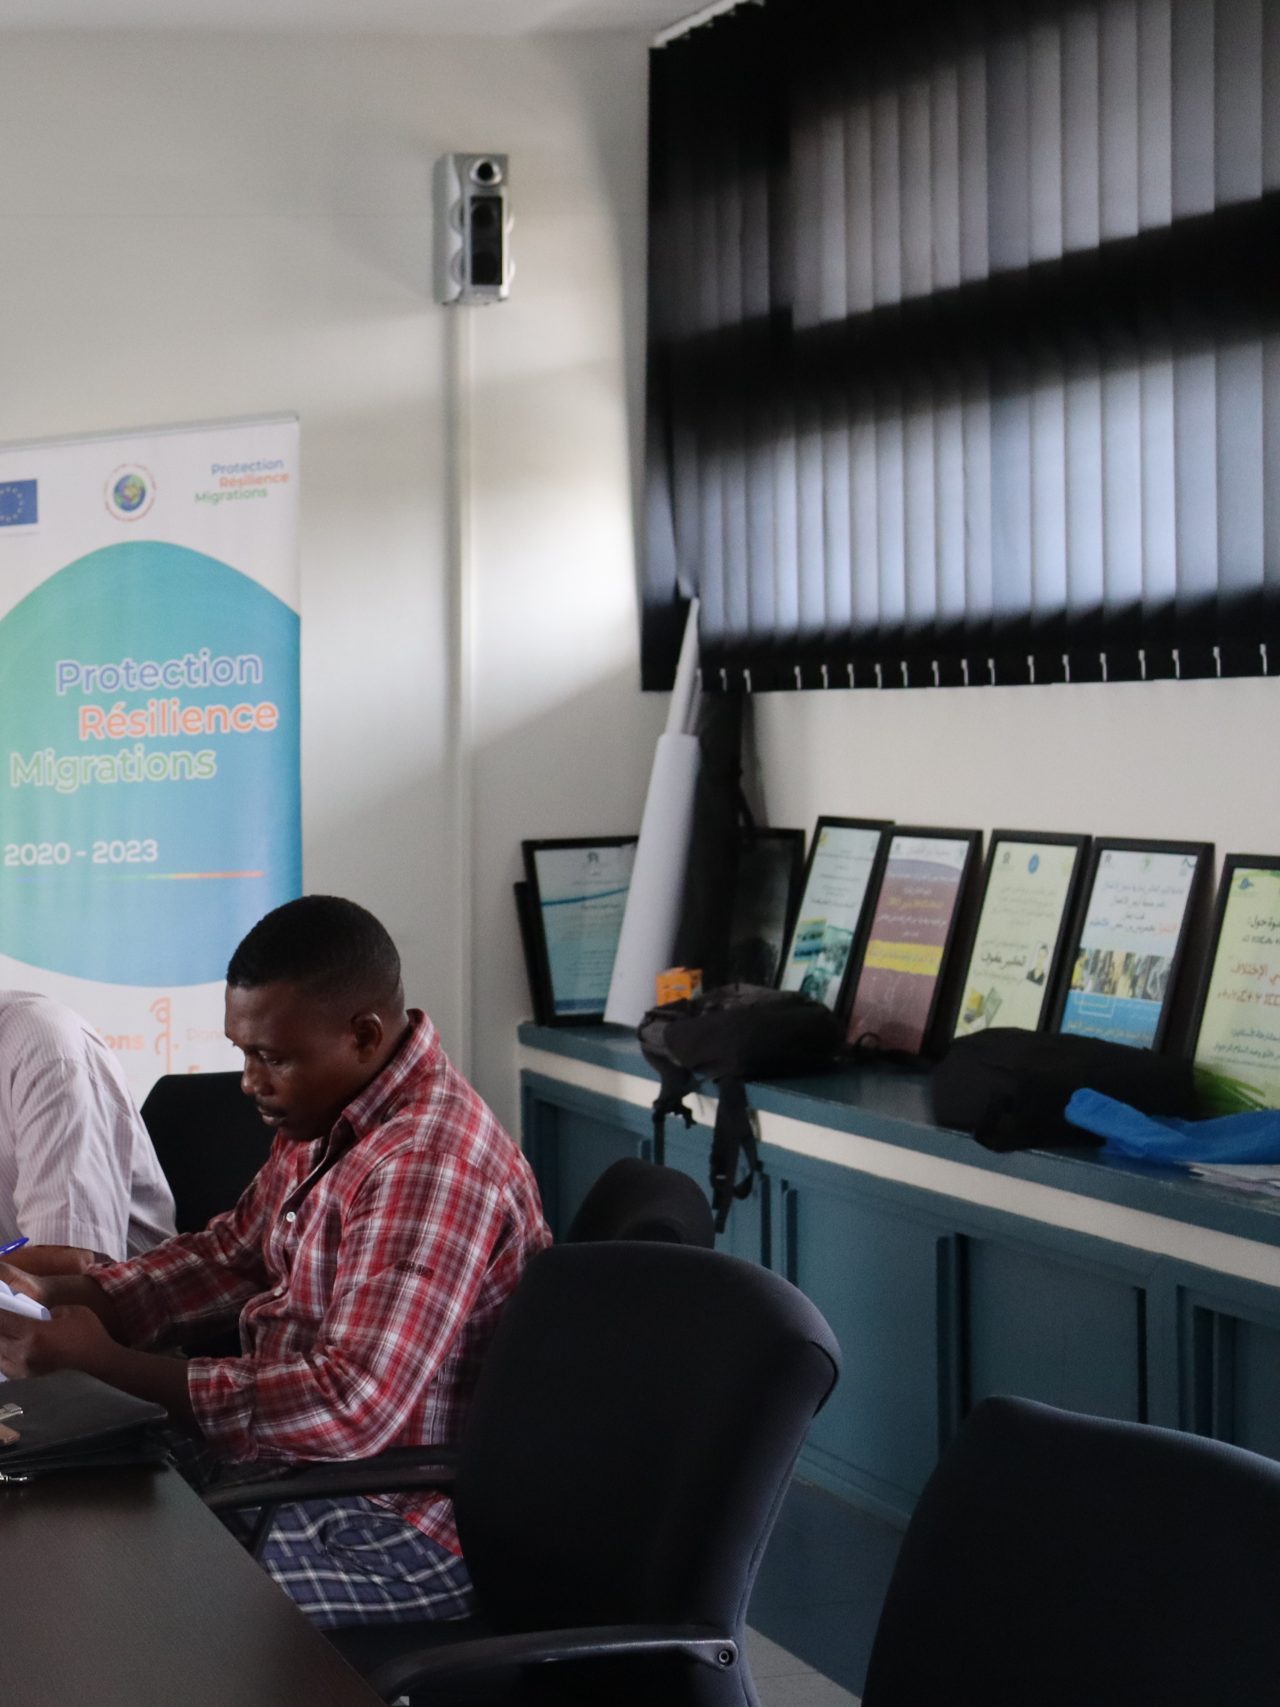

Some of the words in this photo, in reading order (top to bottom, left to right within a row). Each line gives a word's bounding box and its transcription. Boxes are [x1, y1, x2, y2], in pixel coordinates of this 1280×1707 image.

[211, 460, 284, 475] Protection
[194, 488, 267, 505] Migrations
[56, 648, 263, 695] Protection
[79, 698, 279, 740] Résilience
[10, 744, 217, 794] Migrations
[4, 843, 70, 866] 2020
[92, 840, 158, 864] 2023
